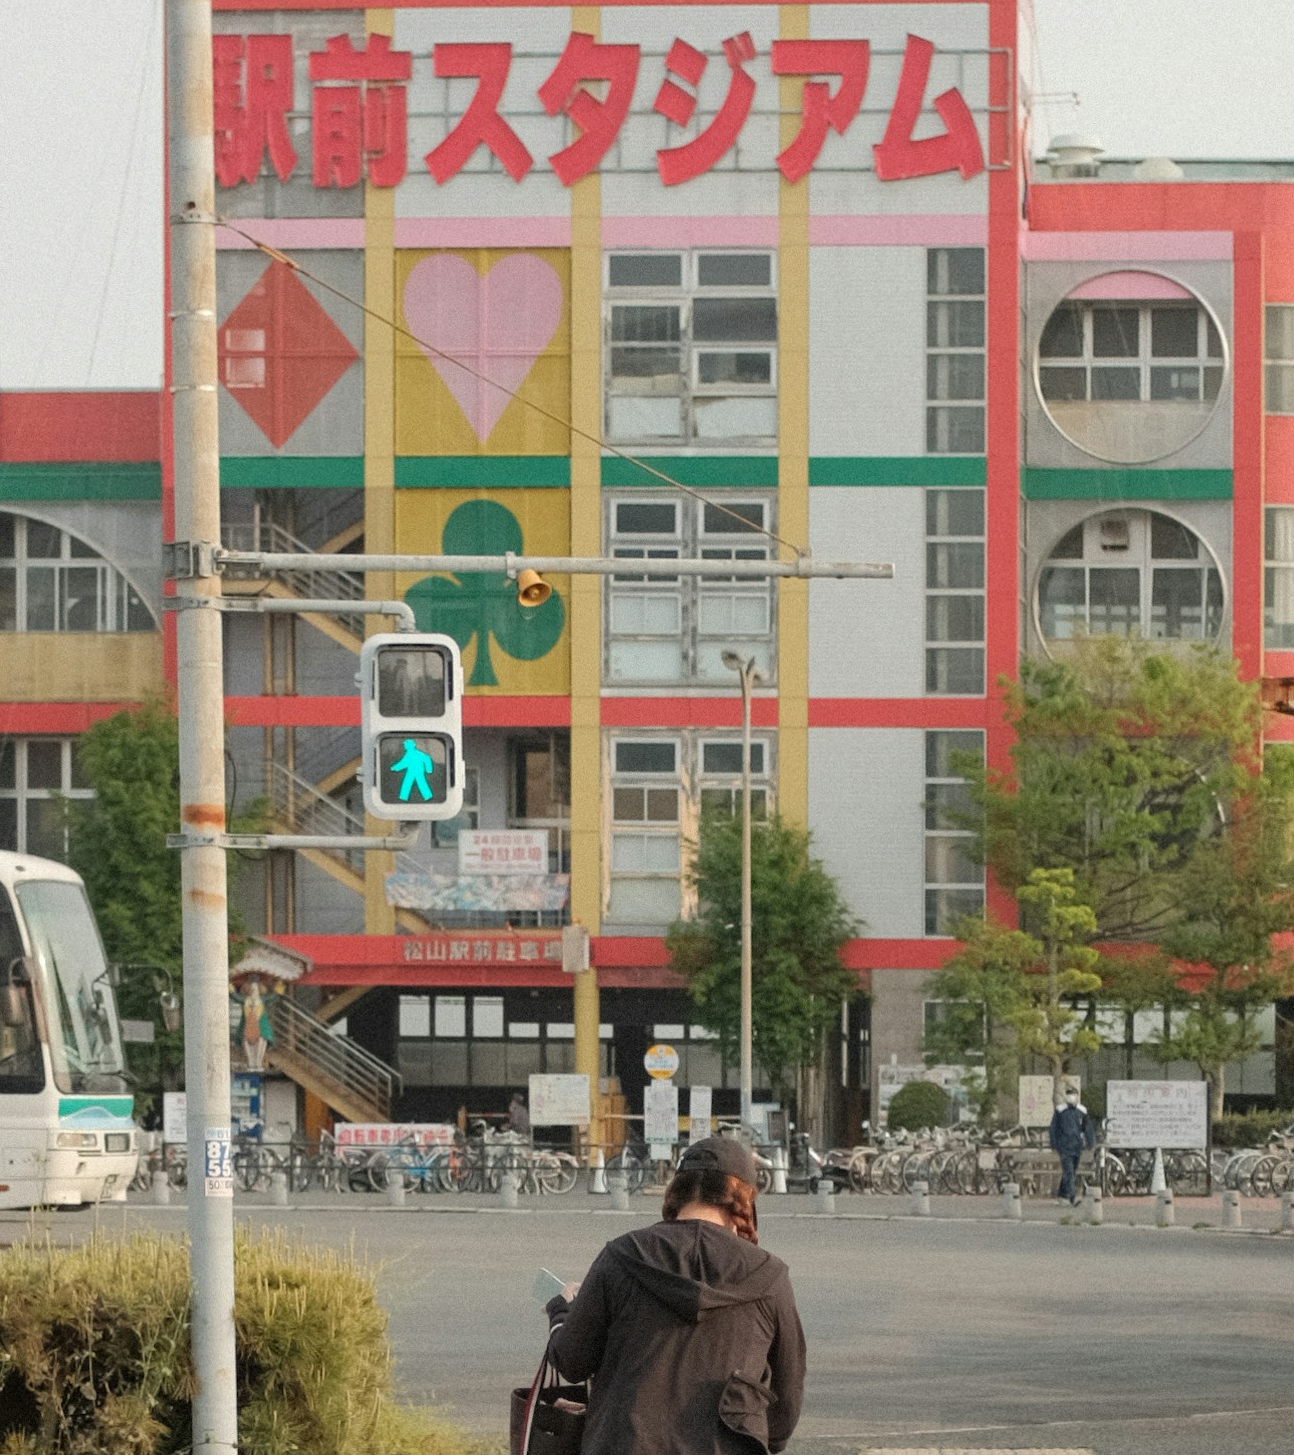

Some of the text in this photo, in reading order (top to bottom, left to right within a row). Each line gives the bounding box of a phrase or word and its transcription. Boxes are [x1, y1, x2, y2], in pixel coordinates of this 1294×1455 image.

[212, 31, 986, 188] 駅前スタジアム
